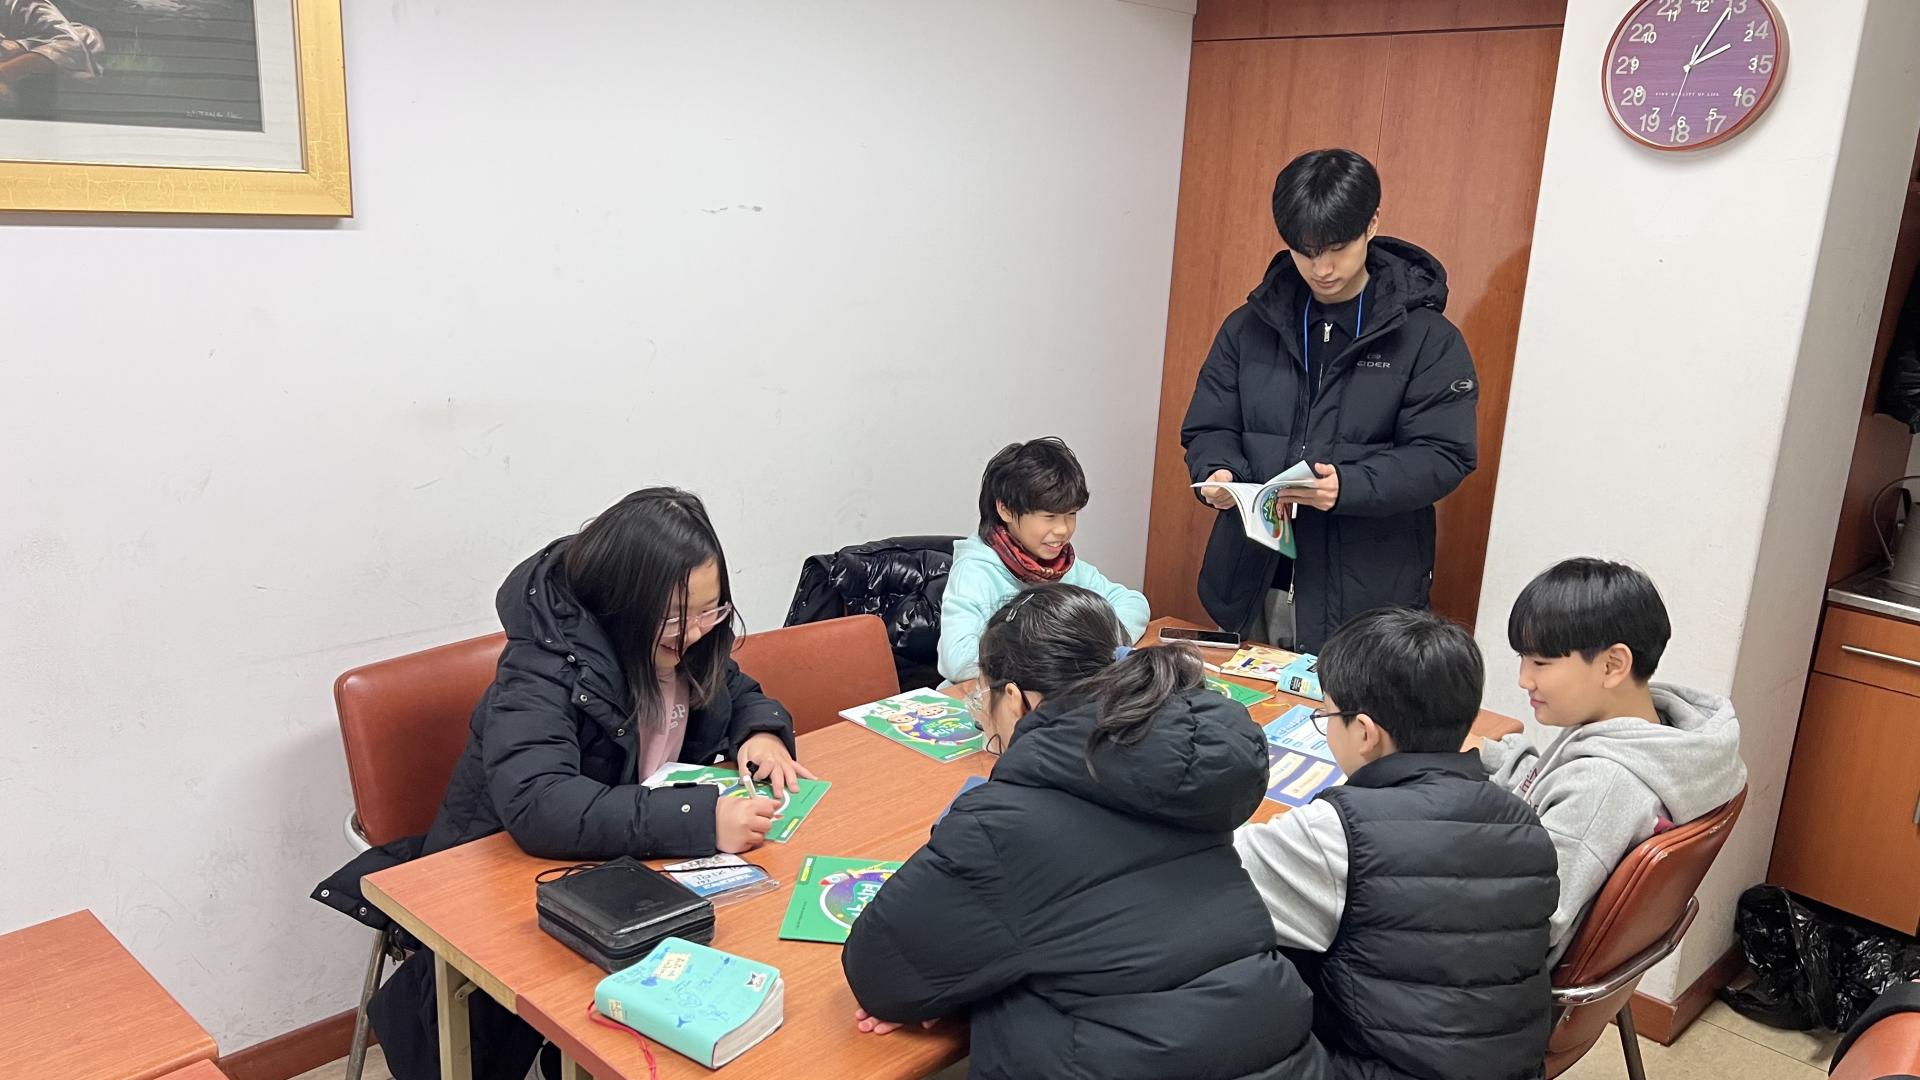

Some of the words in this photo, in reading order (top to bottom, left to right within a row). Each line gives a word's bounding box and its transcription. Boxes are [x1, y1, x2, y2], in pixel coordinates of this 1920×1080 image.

[1657, 0, 1682, 15] 23
[1696, 1, 1709, 12] 12
[1667, 9, 1678, 22] 11
[1743, 29, 1753, 42] 2
[1746, 20, 1768, 39] 14
[1643, 31, 1657, 44] 10
[1631, 58, 1639, 71] 9
[1748, 57, 1757, 70] 3
[1620, 87, 1646, 106] 20
[1634, 85, 1644, 97] 8
[1733, 86, 1742, 98] 4
[1652, 107, 1661, 119] 7
[1709, 108, 1718, 120] 5
[1639, 113, 1660, 132] 19
[1677, 115, 1687, 128] 6
[1705, 115, 1727, 133] 17
[1668, 124, 1690, 143] 18
